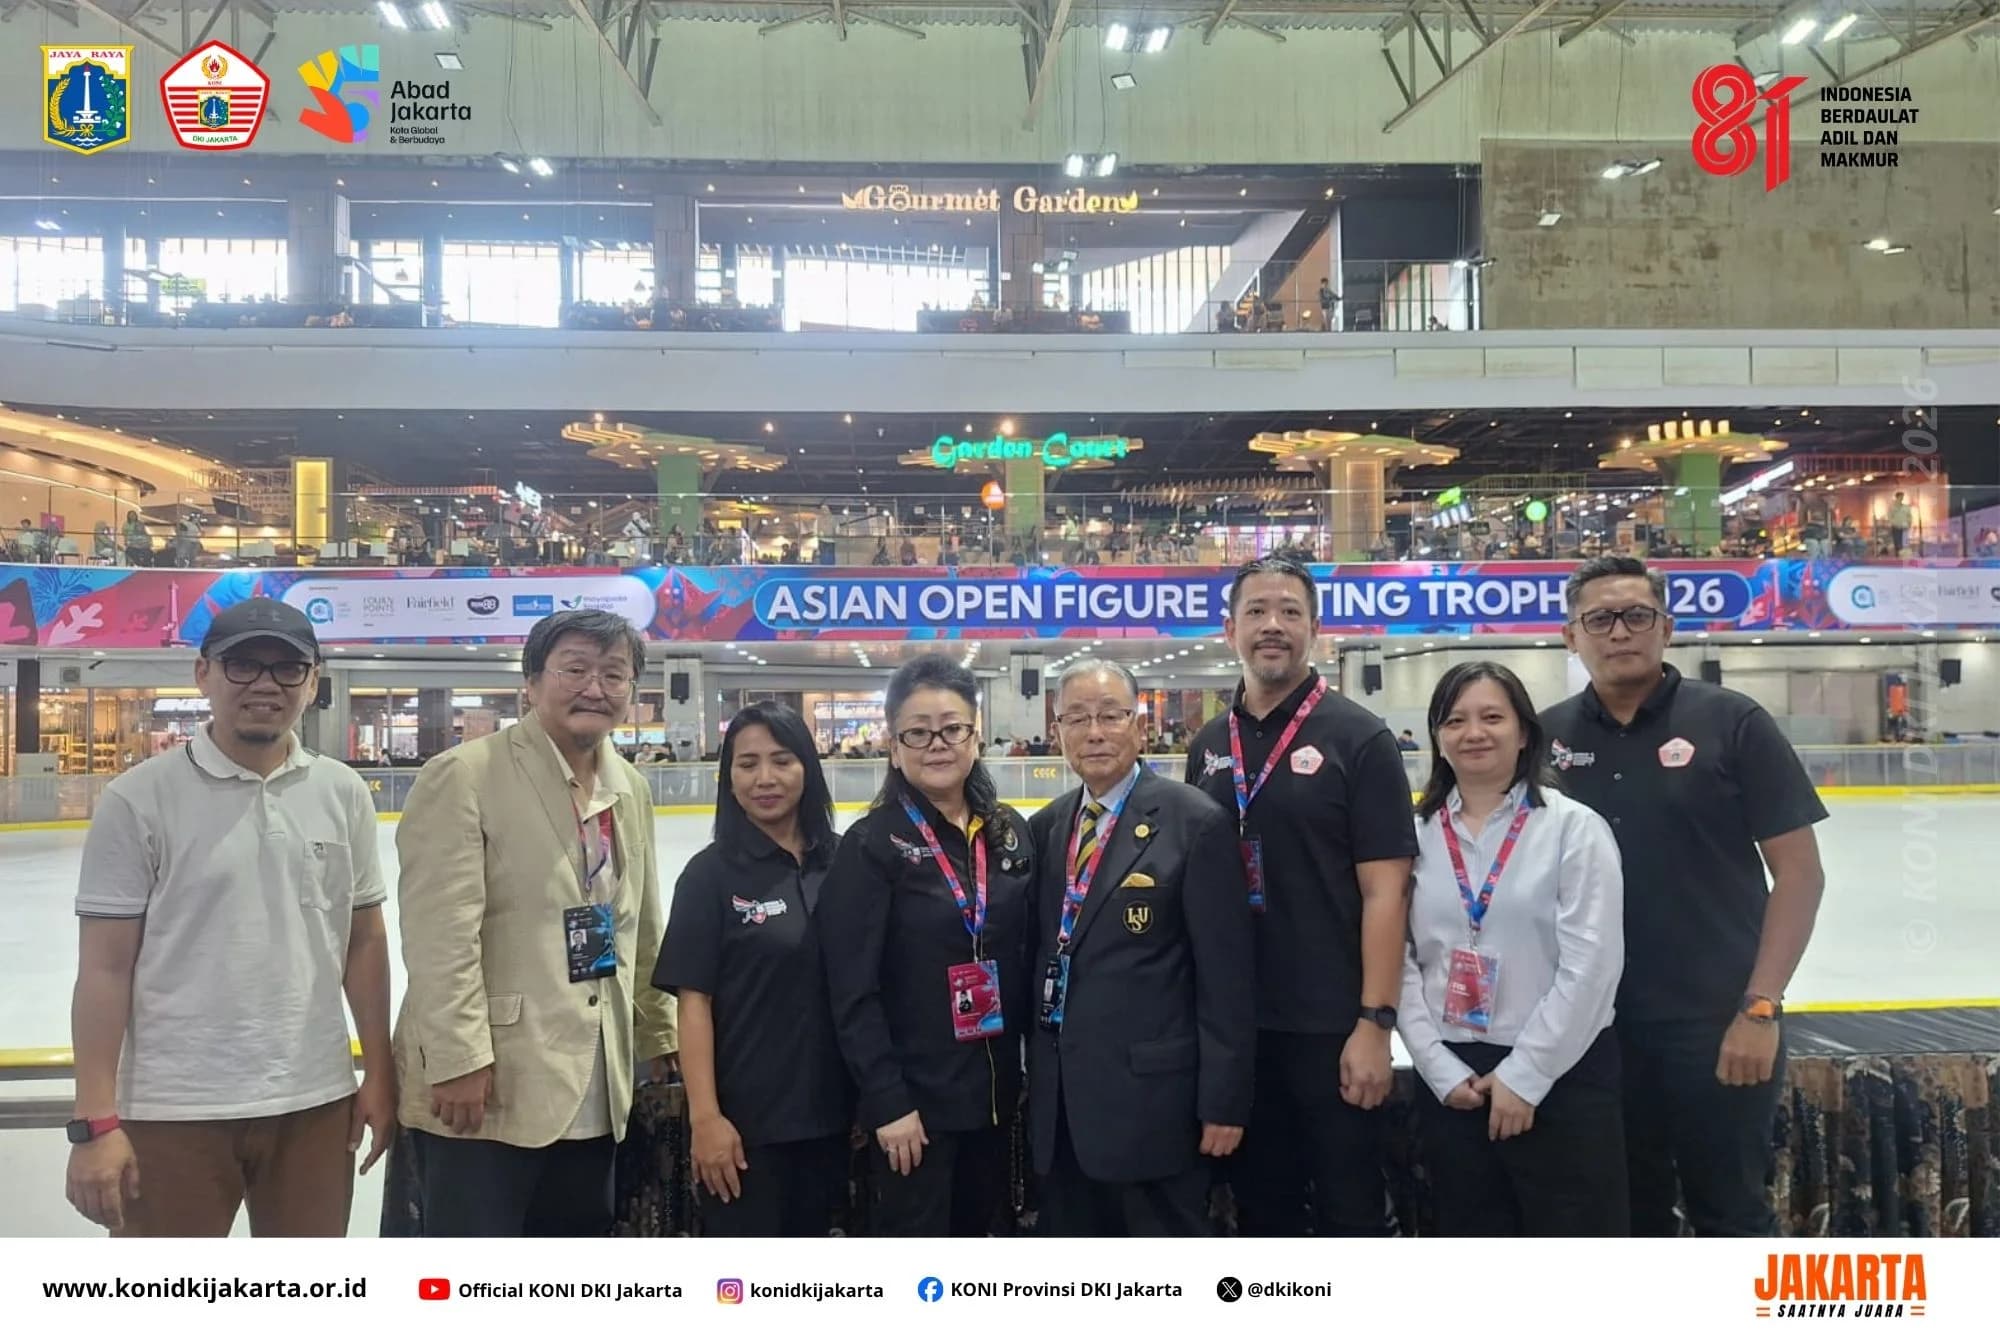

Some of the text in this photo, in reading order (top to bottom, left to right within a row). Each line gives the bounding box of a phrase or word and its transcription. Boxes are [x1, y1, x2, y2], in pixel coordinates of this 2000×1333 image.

[865, 184, 1127, 213] Gourmet Garden
[932, 435, 1033, 468] Garden
[767, 585, 908, 620] ASIAN
[919, 584, 1043, 619] OPEN
[1055, 584, 1210, 618] FIGURE
[1419, 579, 1567, 616] TROPH
